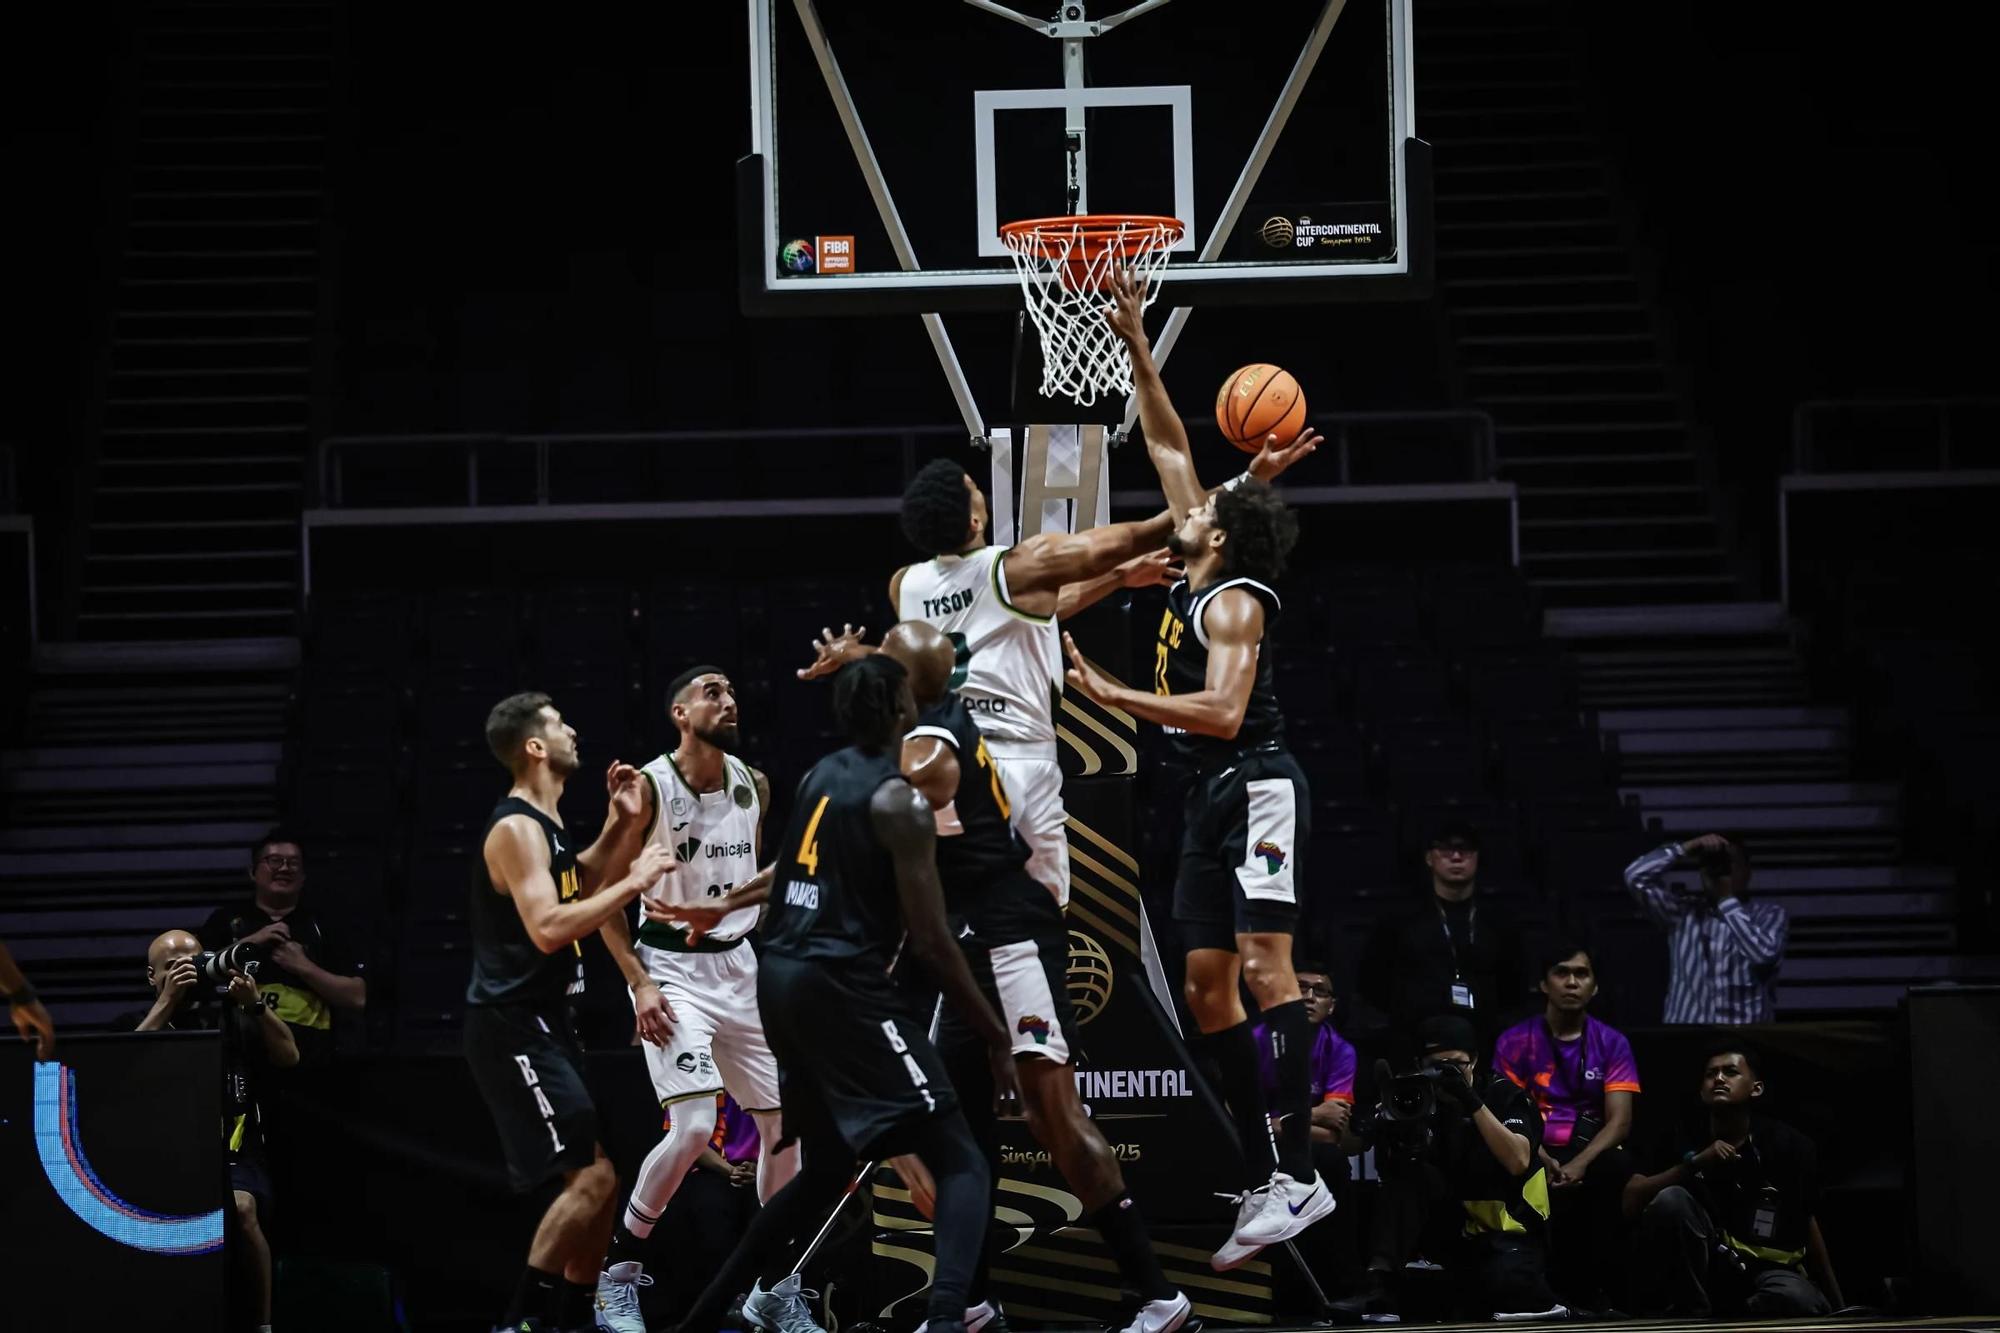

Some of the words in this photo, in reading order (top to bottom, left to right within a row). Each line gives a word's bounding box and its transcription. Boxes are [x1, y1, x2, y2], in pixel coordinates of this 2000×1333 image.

[1296, 224, 1381, 236] INTERCONTINENTAL
[824, 241, 849, 254] FIBA
[1296, 236, 1314, 247] CUP
[923, 588, 974, 618] TYSON
[797, 795, 830, 876] 4
[705, 840, 752, 859] Unicaja
[513, 1053, 566, 1153] BAL
